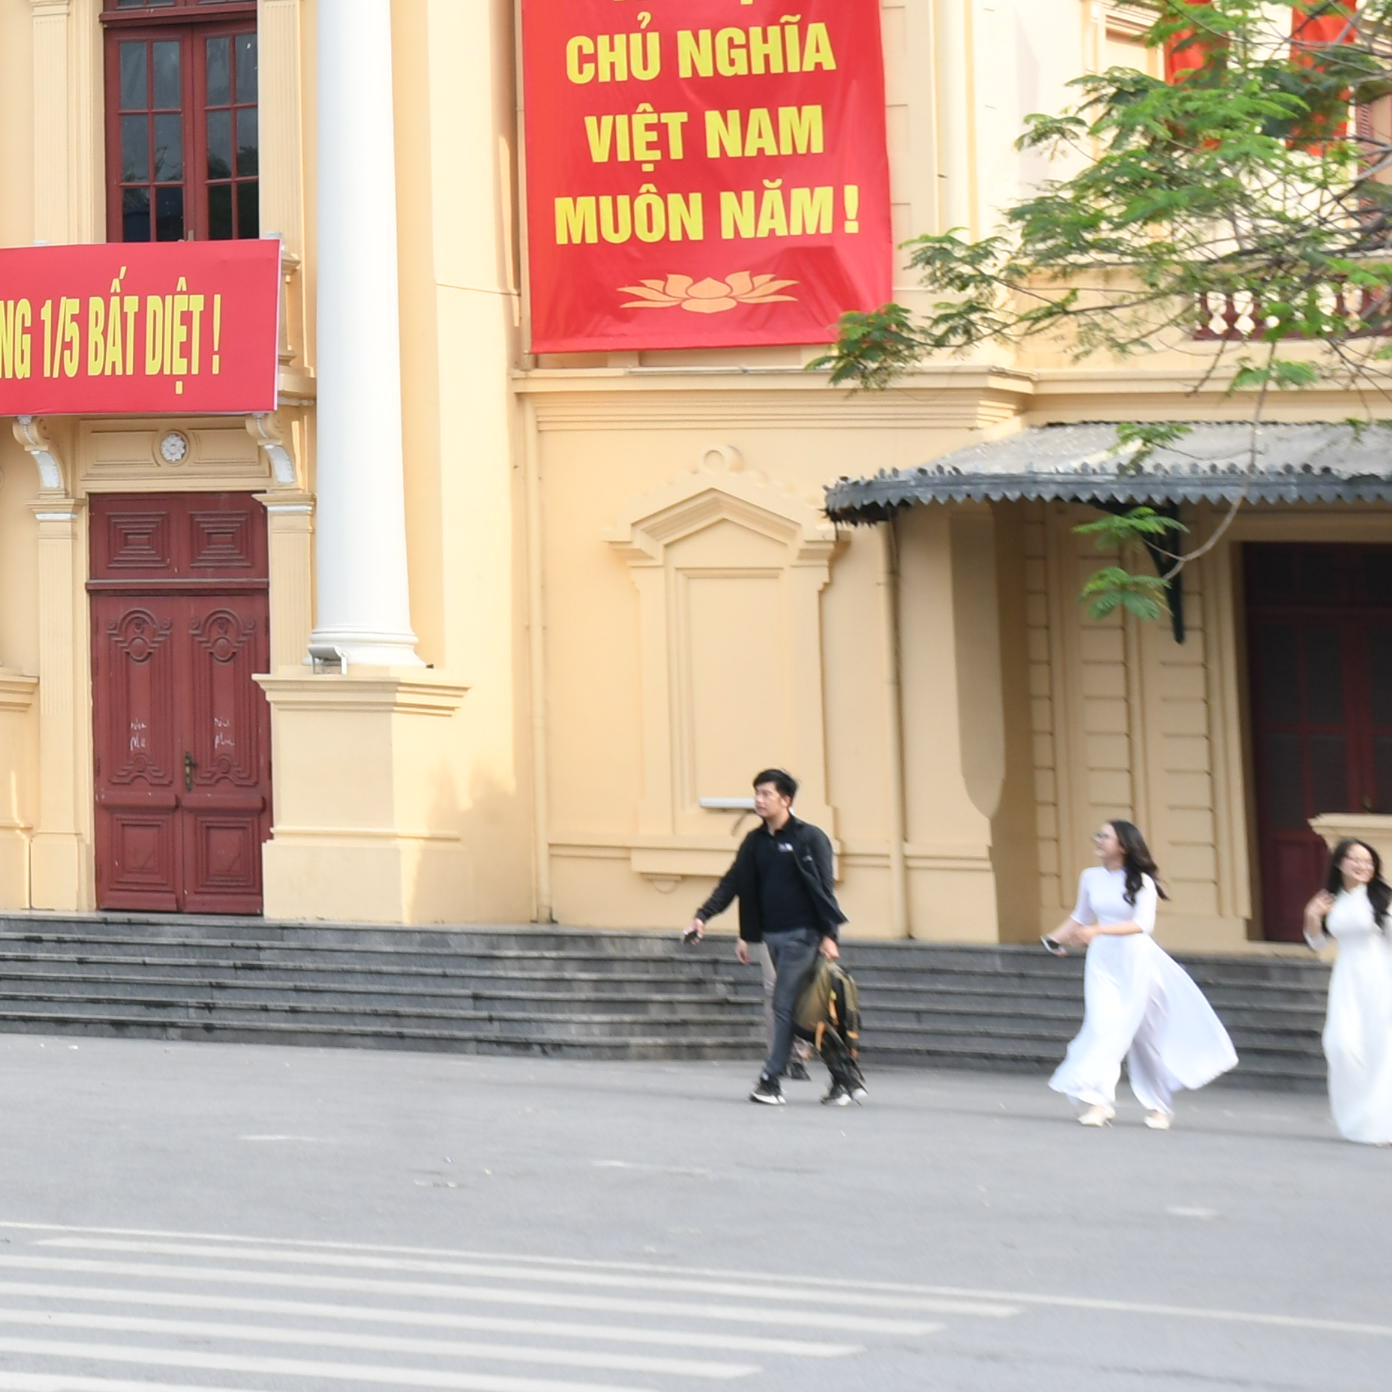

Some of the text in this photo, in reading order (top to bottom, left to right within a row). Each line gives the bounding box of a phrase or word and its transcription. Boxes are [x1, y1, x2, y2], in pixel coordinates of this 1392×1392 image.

[565, 10, 838, 85] CHỦ NGHĨA
[583, 102, 825, 173] VIỆT NAM
[553, 182, 705, 246] MUÔN
[719, 178, 835, 241] NĂM
[39, 295, 81, 379] 1/5
[87, 265, 140, 377] BẤT
[144, 276, 205, 395] DIỆT
